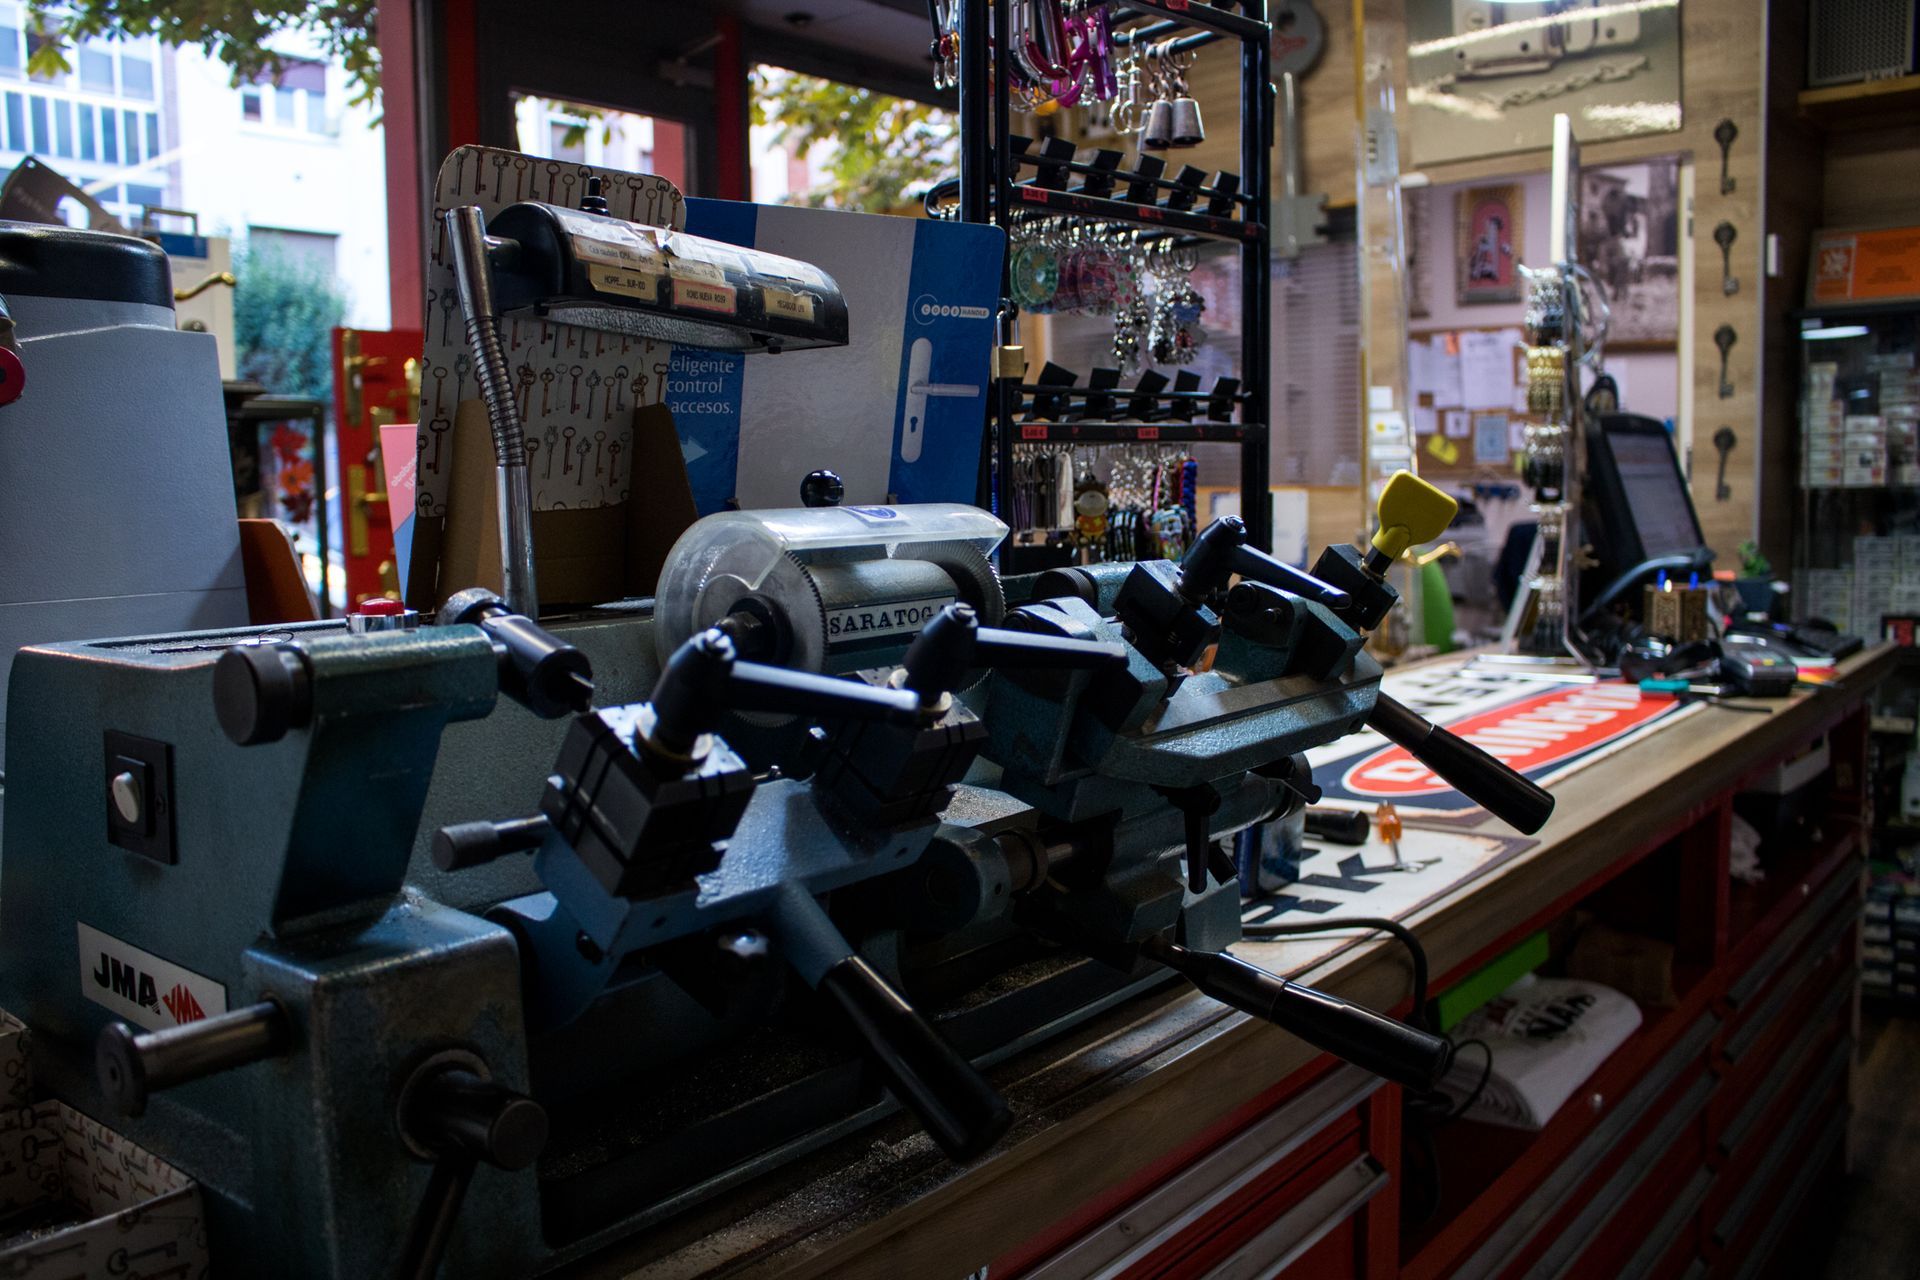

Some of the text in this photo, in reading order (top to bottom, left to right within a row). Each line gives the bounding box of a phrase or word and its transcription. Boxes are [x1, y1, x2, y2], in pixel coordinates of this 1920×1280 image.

[668, 355, 735, 377] eligente
[667, 376, 723, 393] control
[671, 401, 735, 415] accesos.
[829, 603, 946, 635] SARATOG
[94, 951, 161, 1015] JMA
